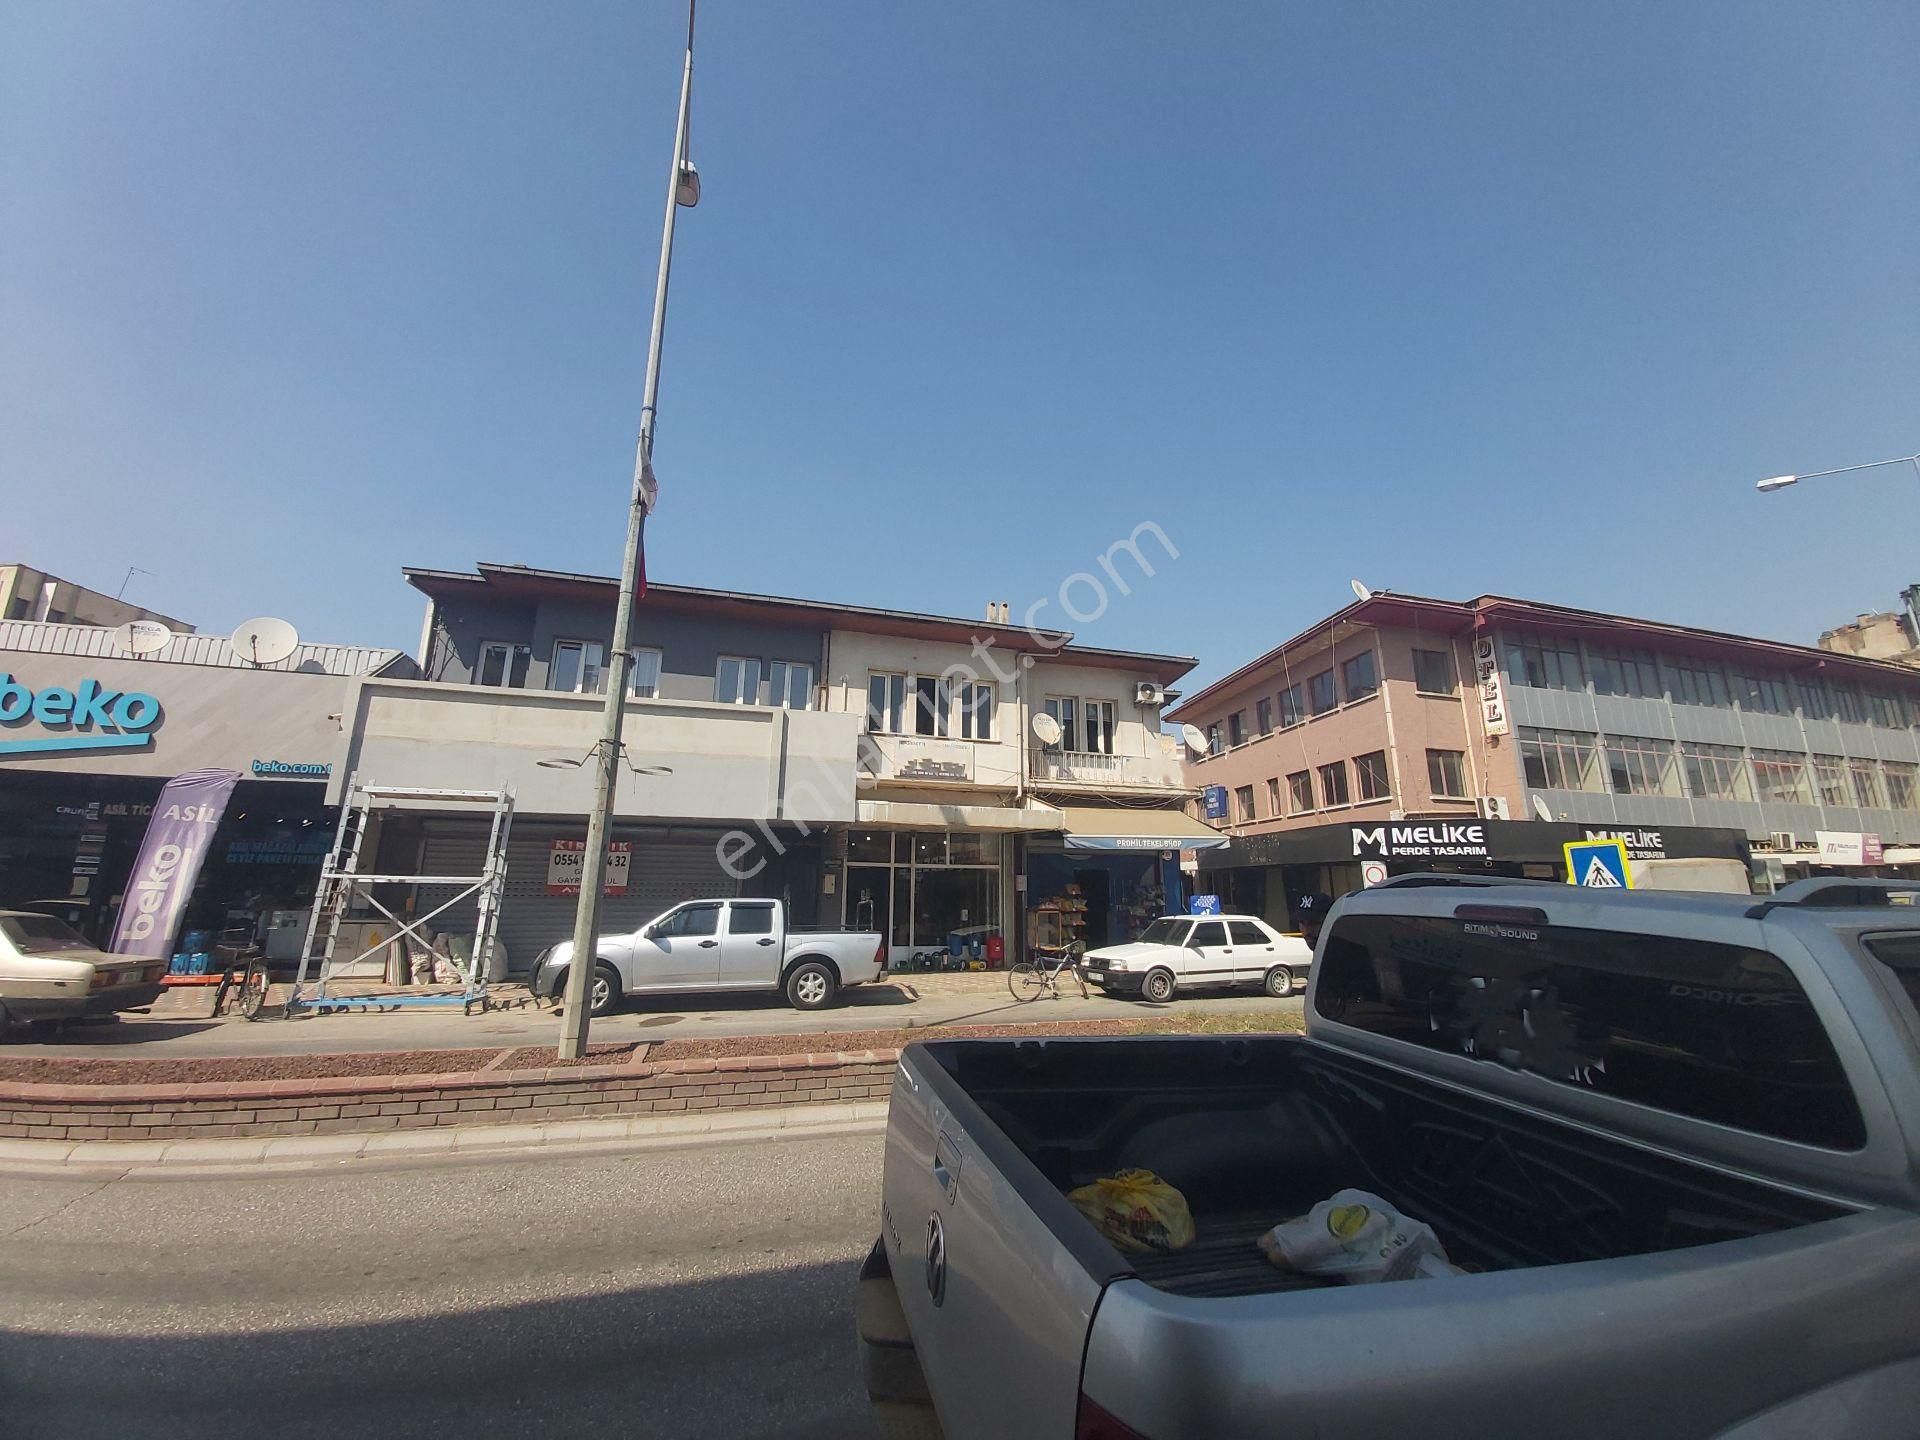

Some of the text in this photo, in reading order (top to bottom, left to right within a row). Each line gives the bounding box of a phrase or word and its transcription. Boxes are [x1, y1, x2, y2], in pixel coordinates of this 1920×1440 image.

[1479, 640, 1503, 722] OTEL
[0, 672, 159, 729] beko
[252, 760, 332, 774] beko.com.t
[162, 803, 217, 823] ASİL
[1391, 823, 1484, 843] MELİKE
[555, 840, 628, 852] KIRIK
[1392, 846, 1487, 856] PERDE TASARIM
[554, 854, 579, 866] 0554
[614, 856, 627, 867] 32
[120, 844, 182, 940] beko
[1500, 929, 1538, 940] SOUND
